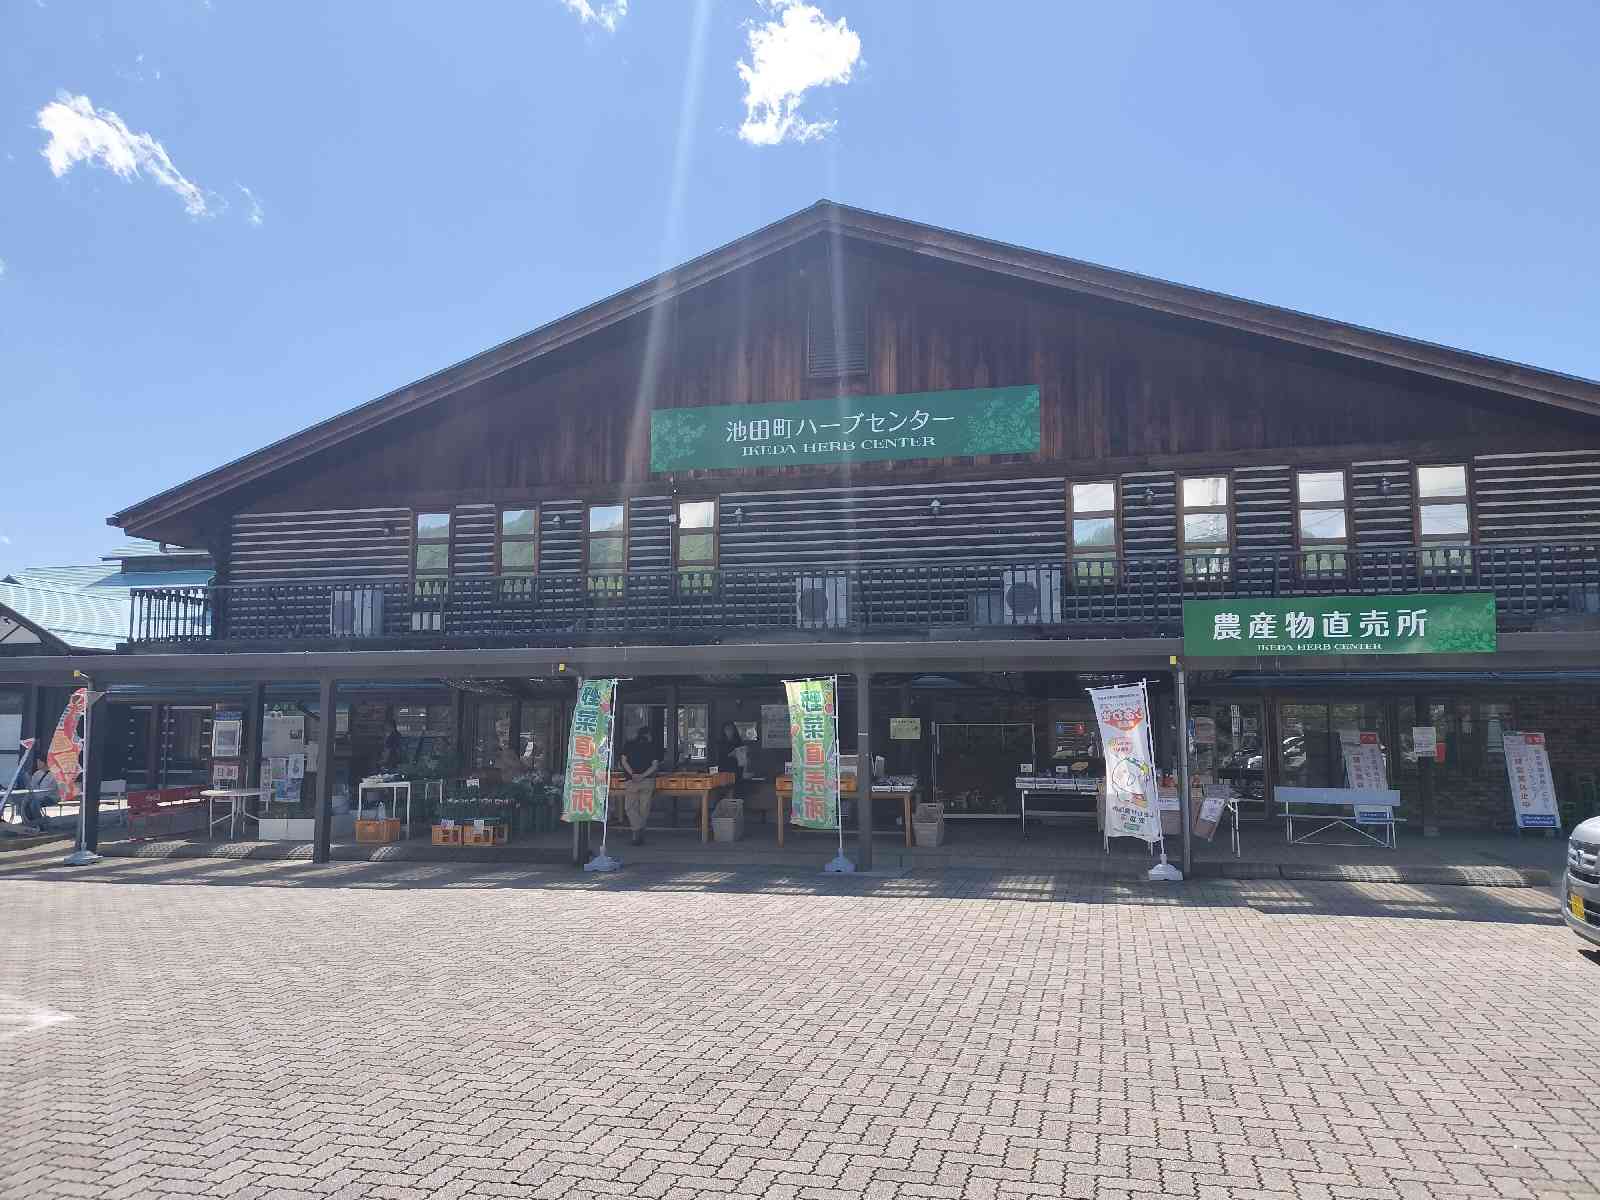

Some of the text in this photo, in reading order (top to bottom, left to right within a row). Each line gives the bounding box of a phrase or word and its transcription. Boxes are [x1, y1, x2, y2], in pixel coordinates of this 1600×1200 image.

[725, 409, 955, 443] 池田町ハーブセンター
[741, 436, 936, 456] IKEDA HERB CENTER
[1212, 609, 1428, 640] 農産物直売所
[1256, 642, 1383, 651] IKEDA HERB CENTER
